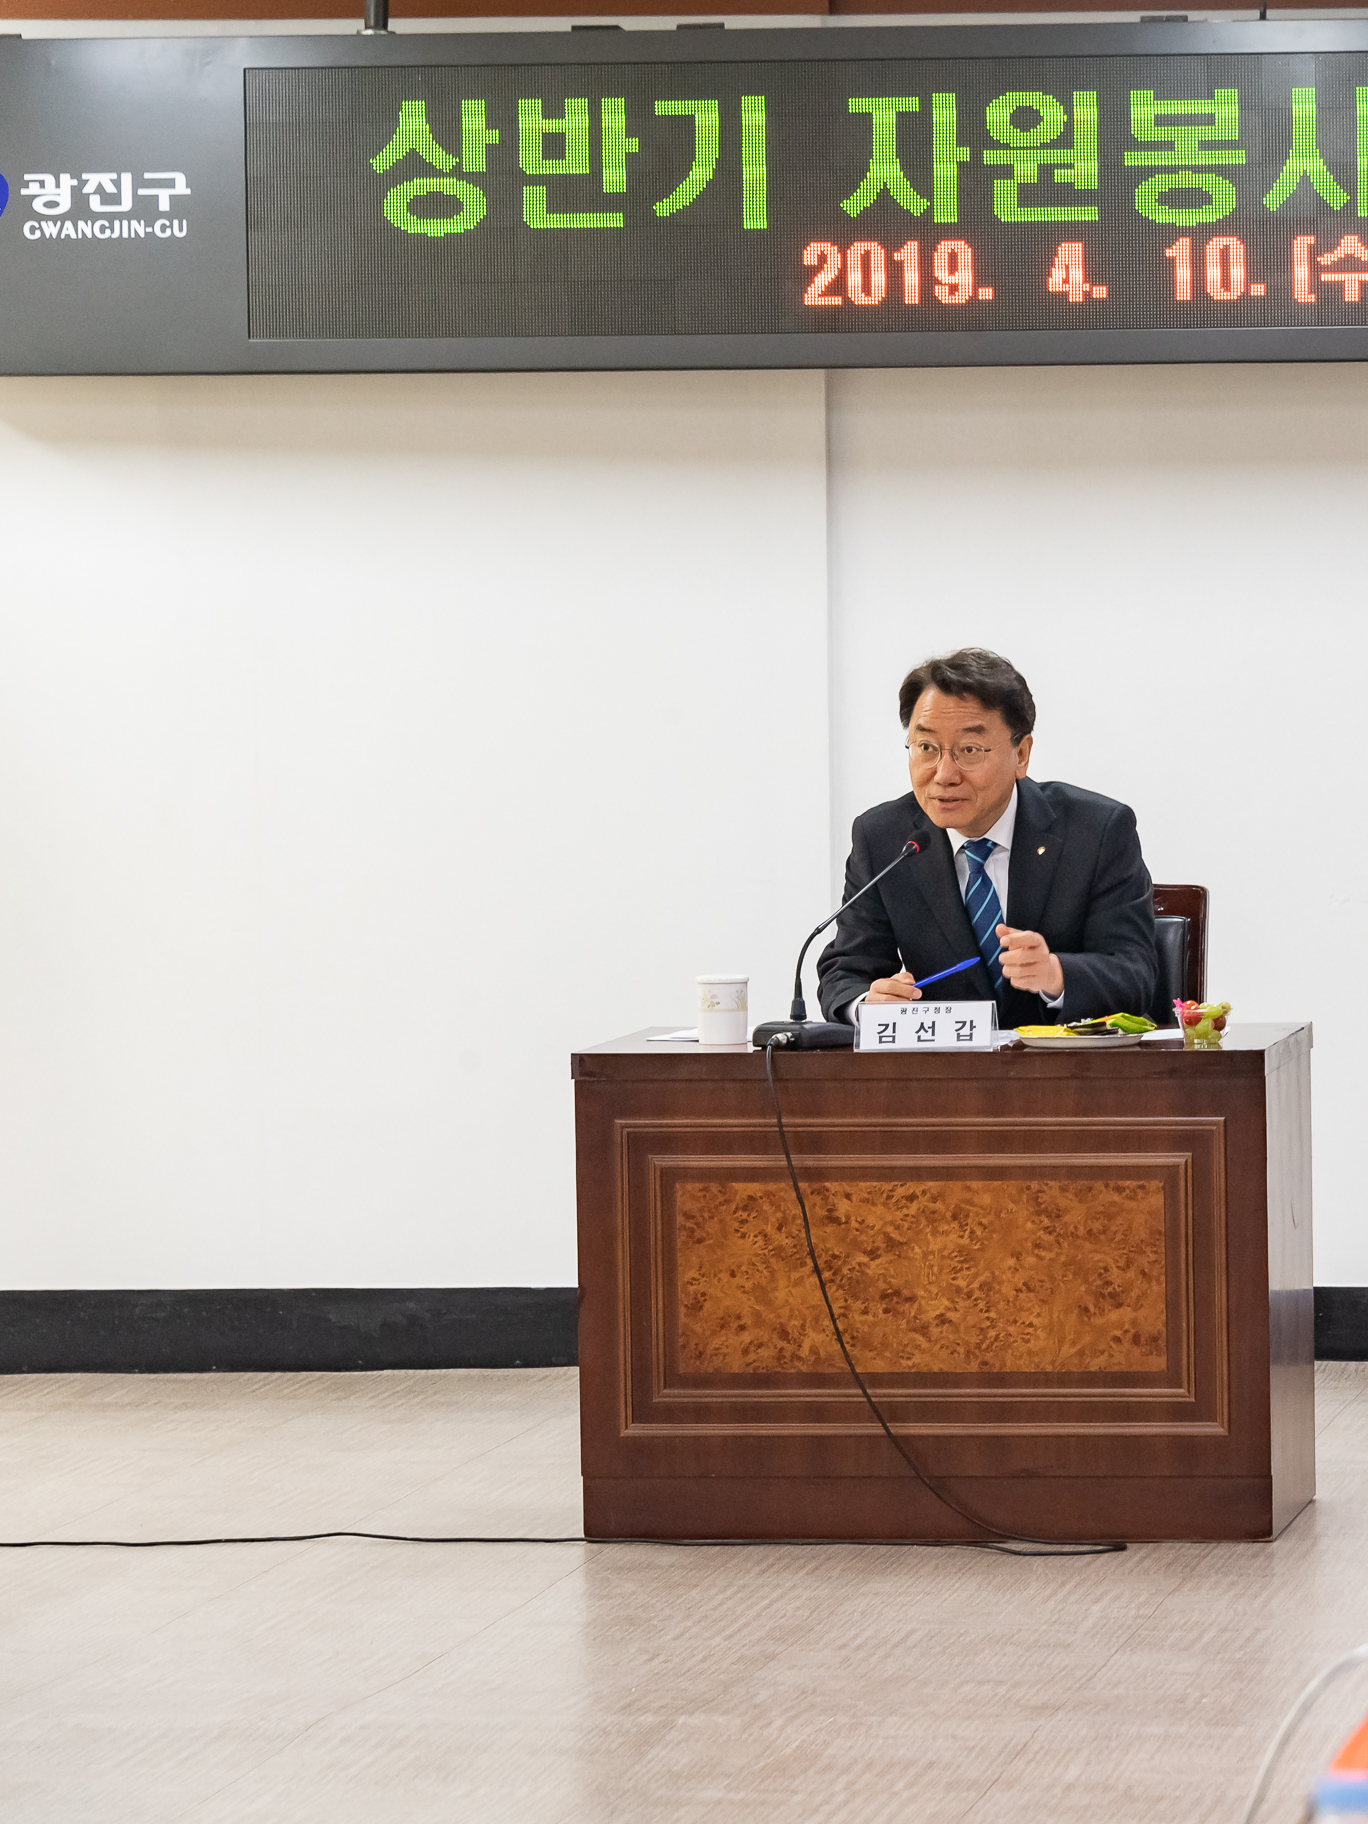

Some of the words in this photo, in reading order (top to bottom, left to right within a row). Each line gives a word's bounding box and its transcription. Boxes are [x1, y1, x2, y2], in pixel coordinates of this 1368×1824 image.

[20, 171, 192, 216] 광진구
[370, 95, 768, 237] 상반기
[22, 218, 188, 240] GWANGJIN-GU
[802, 240, 994, 306] 2019.
[1047, 241, 1108, 303] 4.
